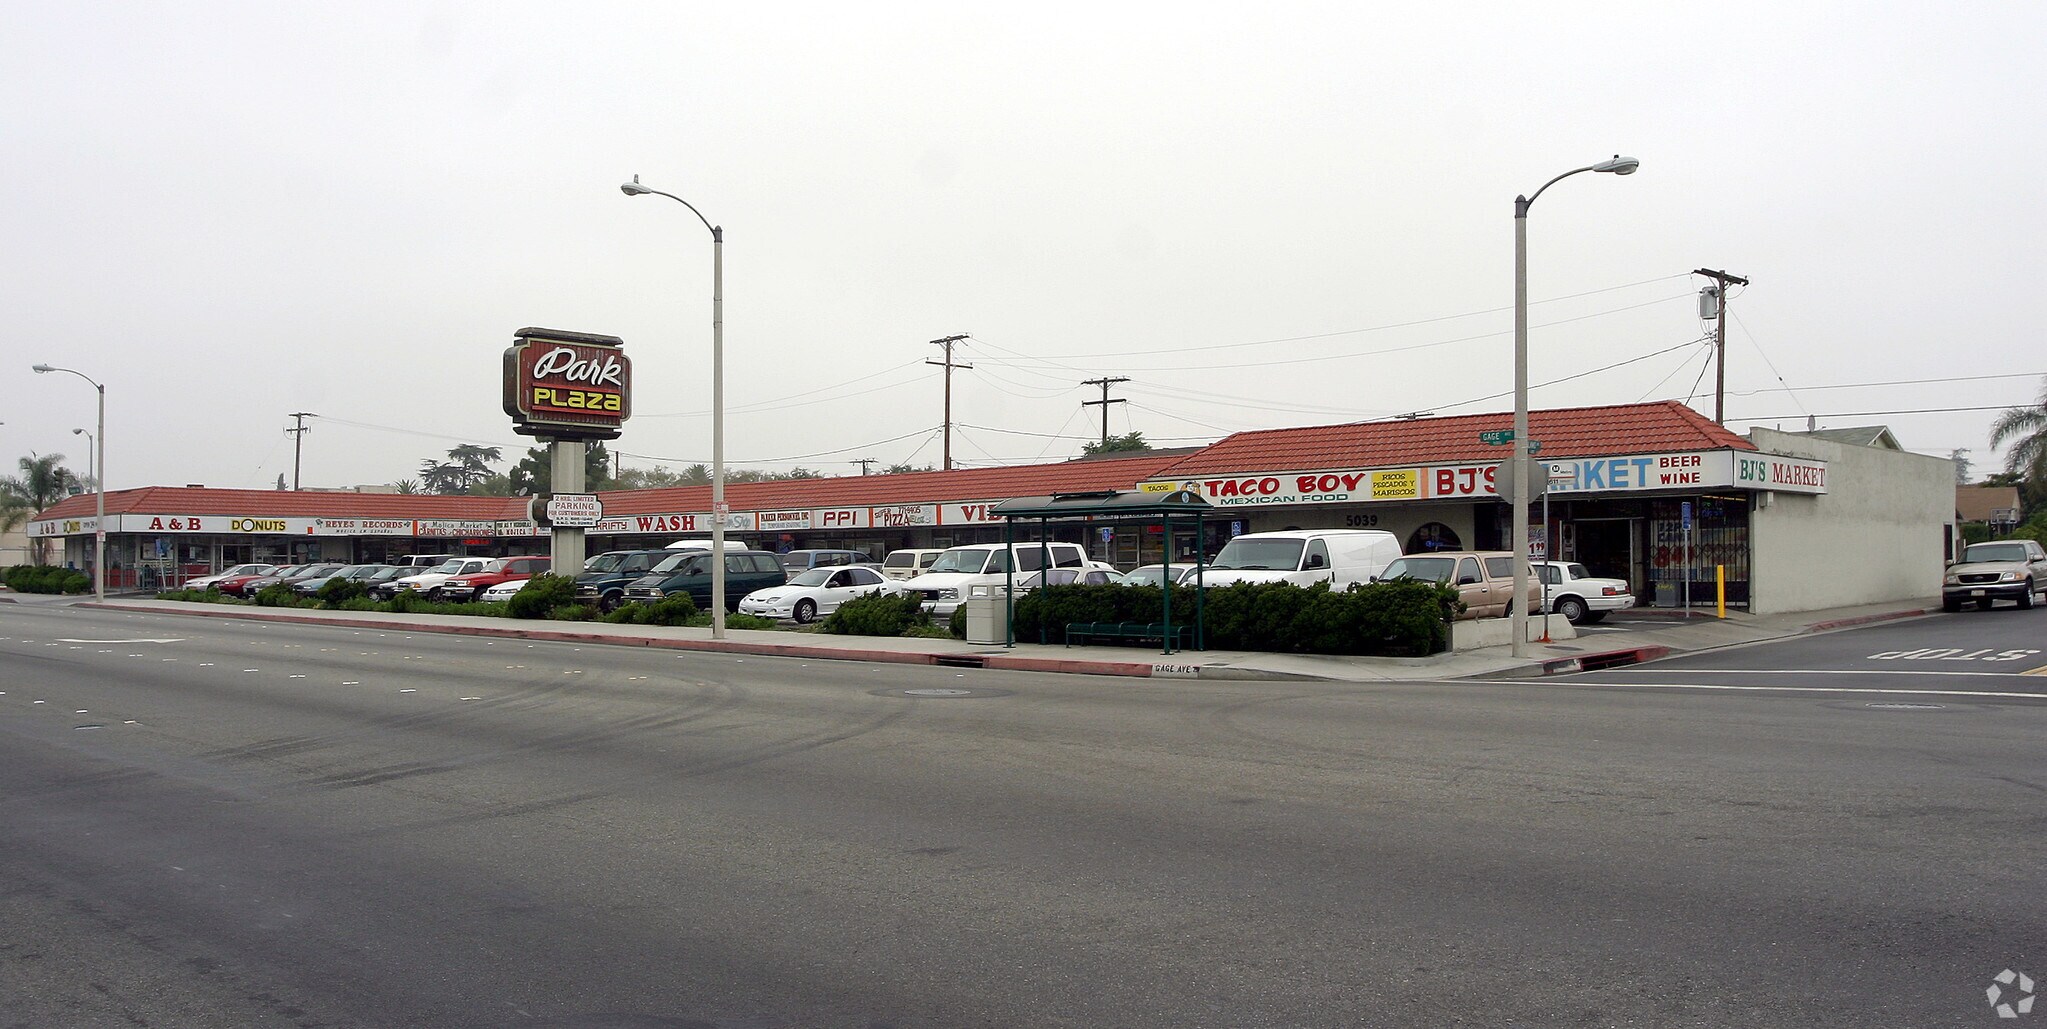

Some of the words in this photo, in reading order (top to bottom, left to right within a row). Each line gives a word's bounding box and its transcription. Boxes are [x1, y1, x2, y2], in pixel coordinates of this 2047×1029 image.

[533, 346, 621, 386] Park
[1482, 432, 1500, 441] GAGE
[1659, 455, 1701, 468] BEER
[1382, 473, 1406, 481] RICOS
[1660, 472, 1701, 485] WINE
[1740, 458, 1766, 483] BJ'S
[1772, 462, 1826, 488] MARKET
[1204, 477, 1280, 497] TACO
[1296, 472, 1366, 493] BOY
[1437, 466, 1498, 496] BJ'S
[1220, 495, 1296, 505] MEXICAN
[1301, 493, 1348, 502] FOOD
[1373, 488, 1416, 497] MARISCOS
[555, 502, 594, 510] PARKING
[149, 516, 164, 530] A
[168, 518, 183, 530] &
[186, 517, 202, 530] B
[231, 518, 286, 532] DONUTS
[325, 520, 355, 528] REYES
[362, 521, 403, 529] RECORDS
[636, 515, 696, 532] WASH
[823, 511, 857, 526] PPI
[884, 512, 911, 527] PIZZA
[1346, 514, 1378, 527] 5039
[418, 528, 447, 536] CARNITAS
[1867, 648, 2041, 662] STOP
[1155, 664, 1175, 673] GAGE
